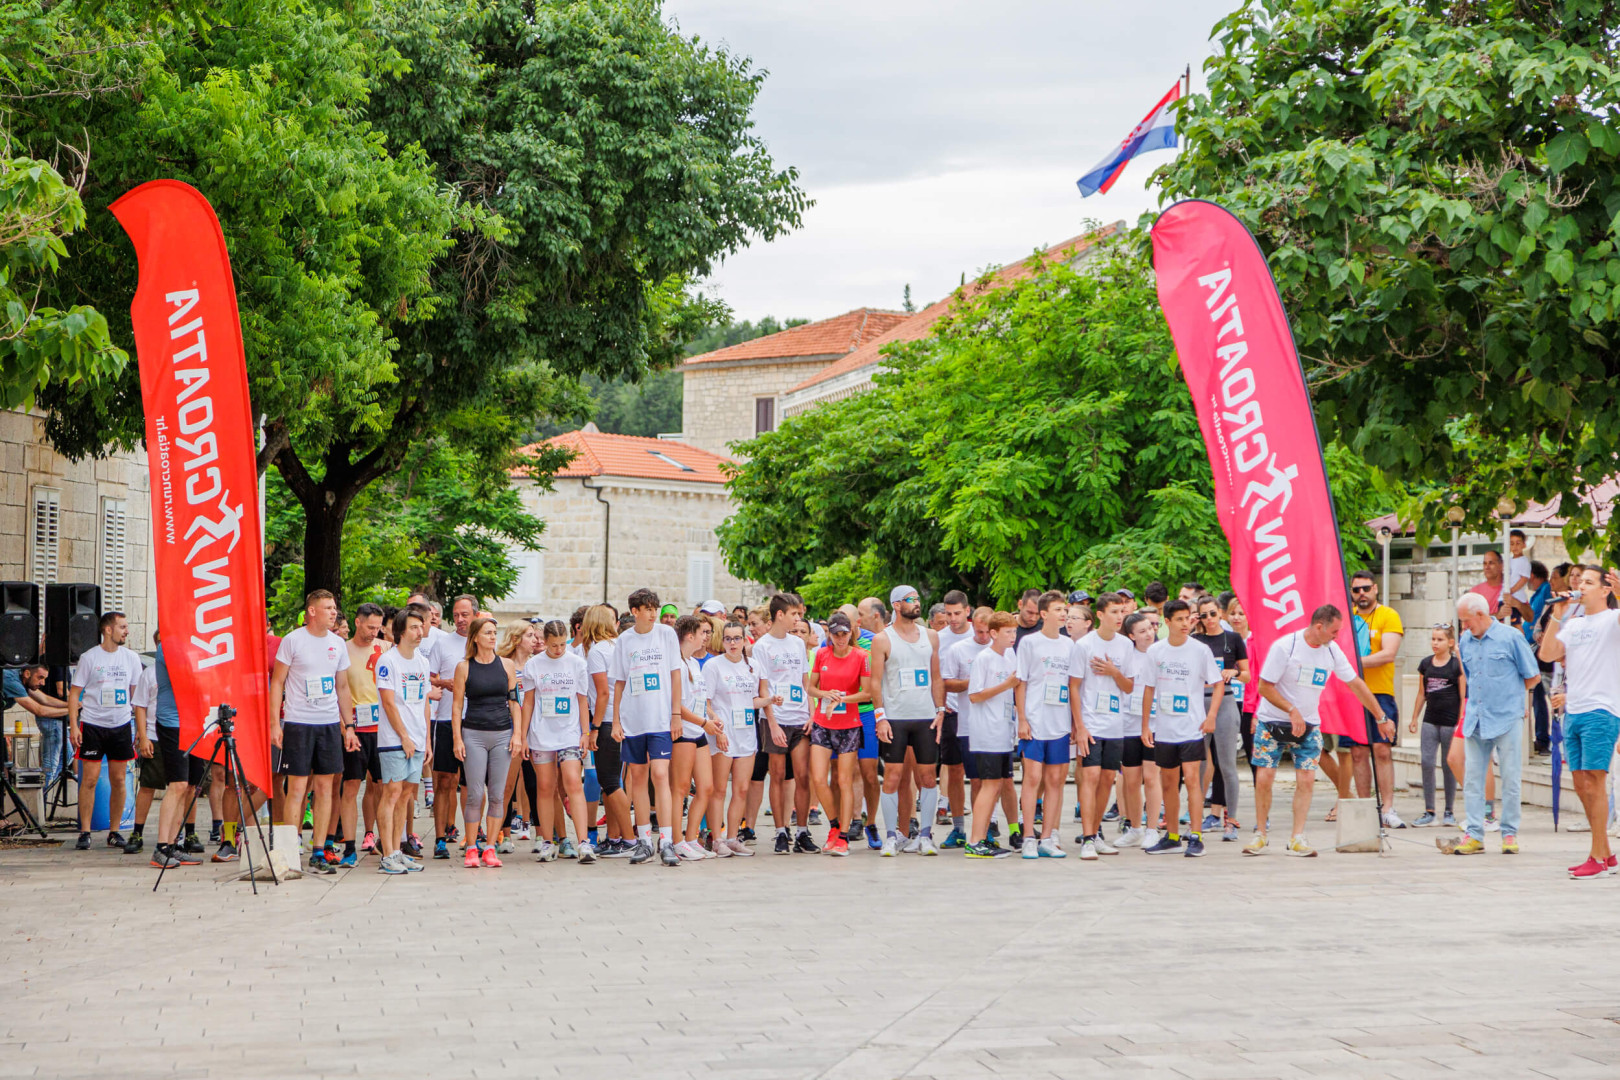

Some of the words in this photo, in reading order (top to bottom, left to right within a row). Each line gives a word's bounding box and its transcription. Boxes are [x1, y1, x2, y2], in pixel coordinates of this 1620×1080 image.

[919, 673, 924, 682] 6
[1315, 672, 1325, 682] 79
[324, 680, 332, 691] 38
[646, 677, 658, 687] 50
[117, 693, 125, 701] 24
[791, 689, 800, 698] 64
[557, 701, 568, 710] 49
[1174, 699, 1187, 709] 44
